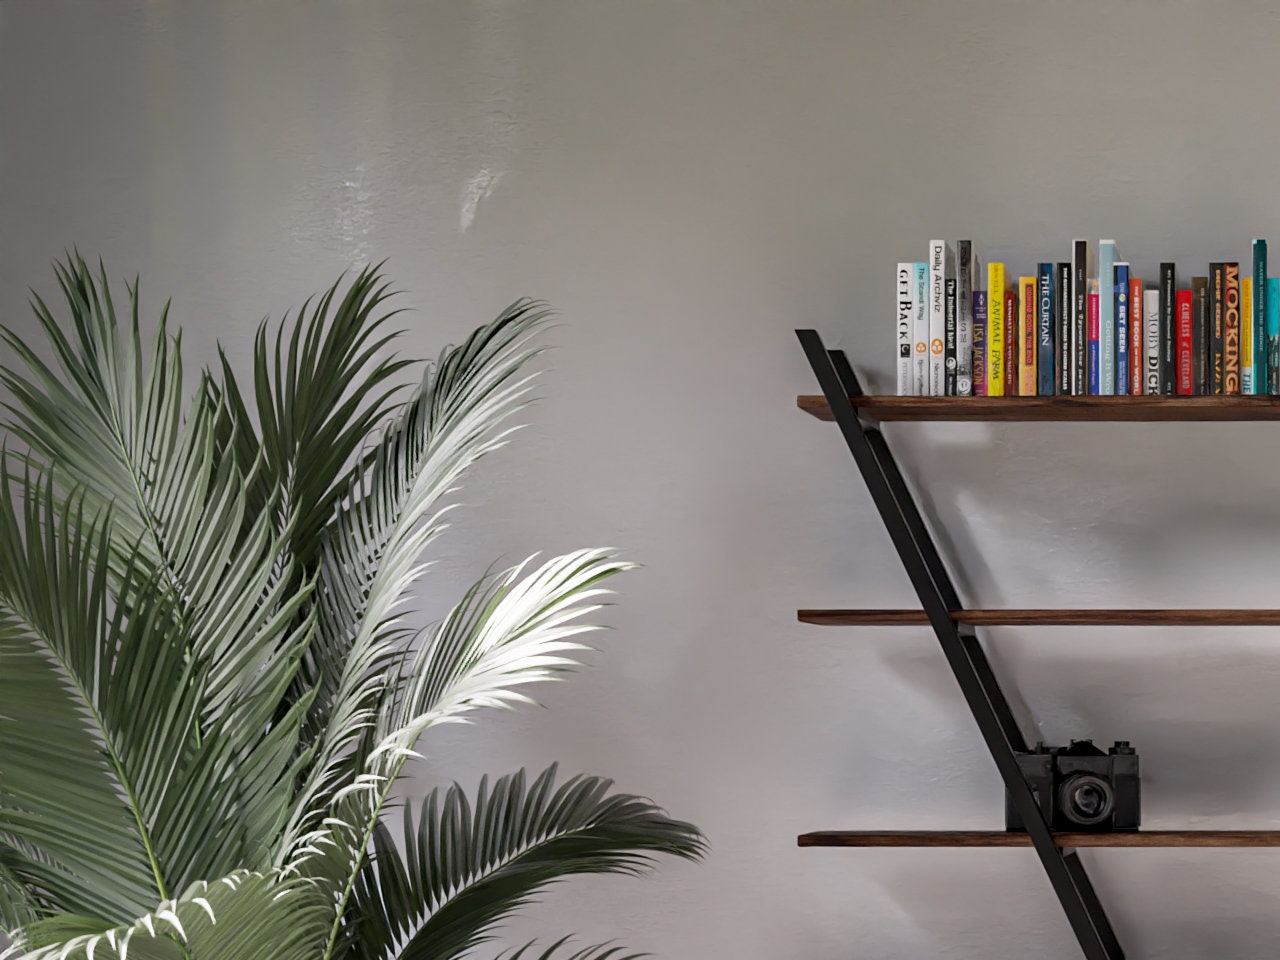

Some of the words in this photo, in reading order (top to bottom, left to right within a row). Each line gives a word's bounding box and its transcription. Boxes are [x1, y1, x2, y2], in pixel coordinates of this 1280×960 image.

[932, 246, 942, 271] Daily
[900, 270, 908, 297] GET
[934, 275, 942, 313] Archviz
[1042, 274, 1050, 296] THE
[900, 301, 912, 339] BACK
[917, 306, 925, 320] Way
[992, 299, 1001, 344] ANIMAL
[1042, 297, 1051, 346] CURTAIN
[1148, 312, 1158, 351] MOBY
[1181, 303, 1190, 337] CLUELESS
[1225, 265, 1239, 396] MOCKING
[973, 323, 984, 343] LISA
[973, 346, 984, 385] JACKSON
[992, 350, 1001, 380] FARM
[1148, 356, 1158, 396] DICK
[1181, 350, 1190, 389] CLEVELAND
[1243, 373, 1251, 394] THE
